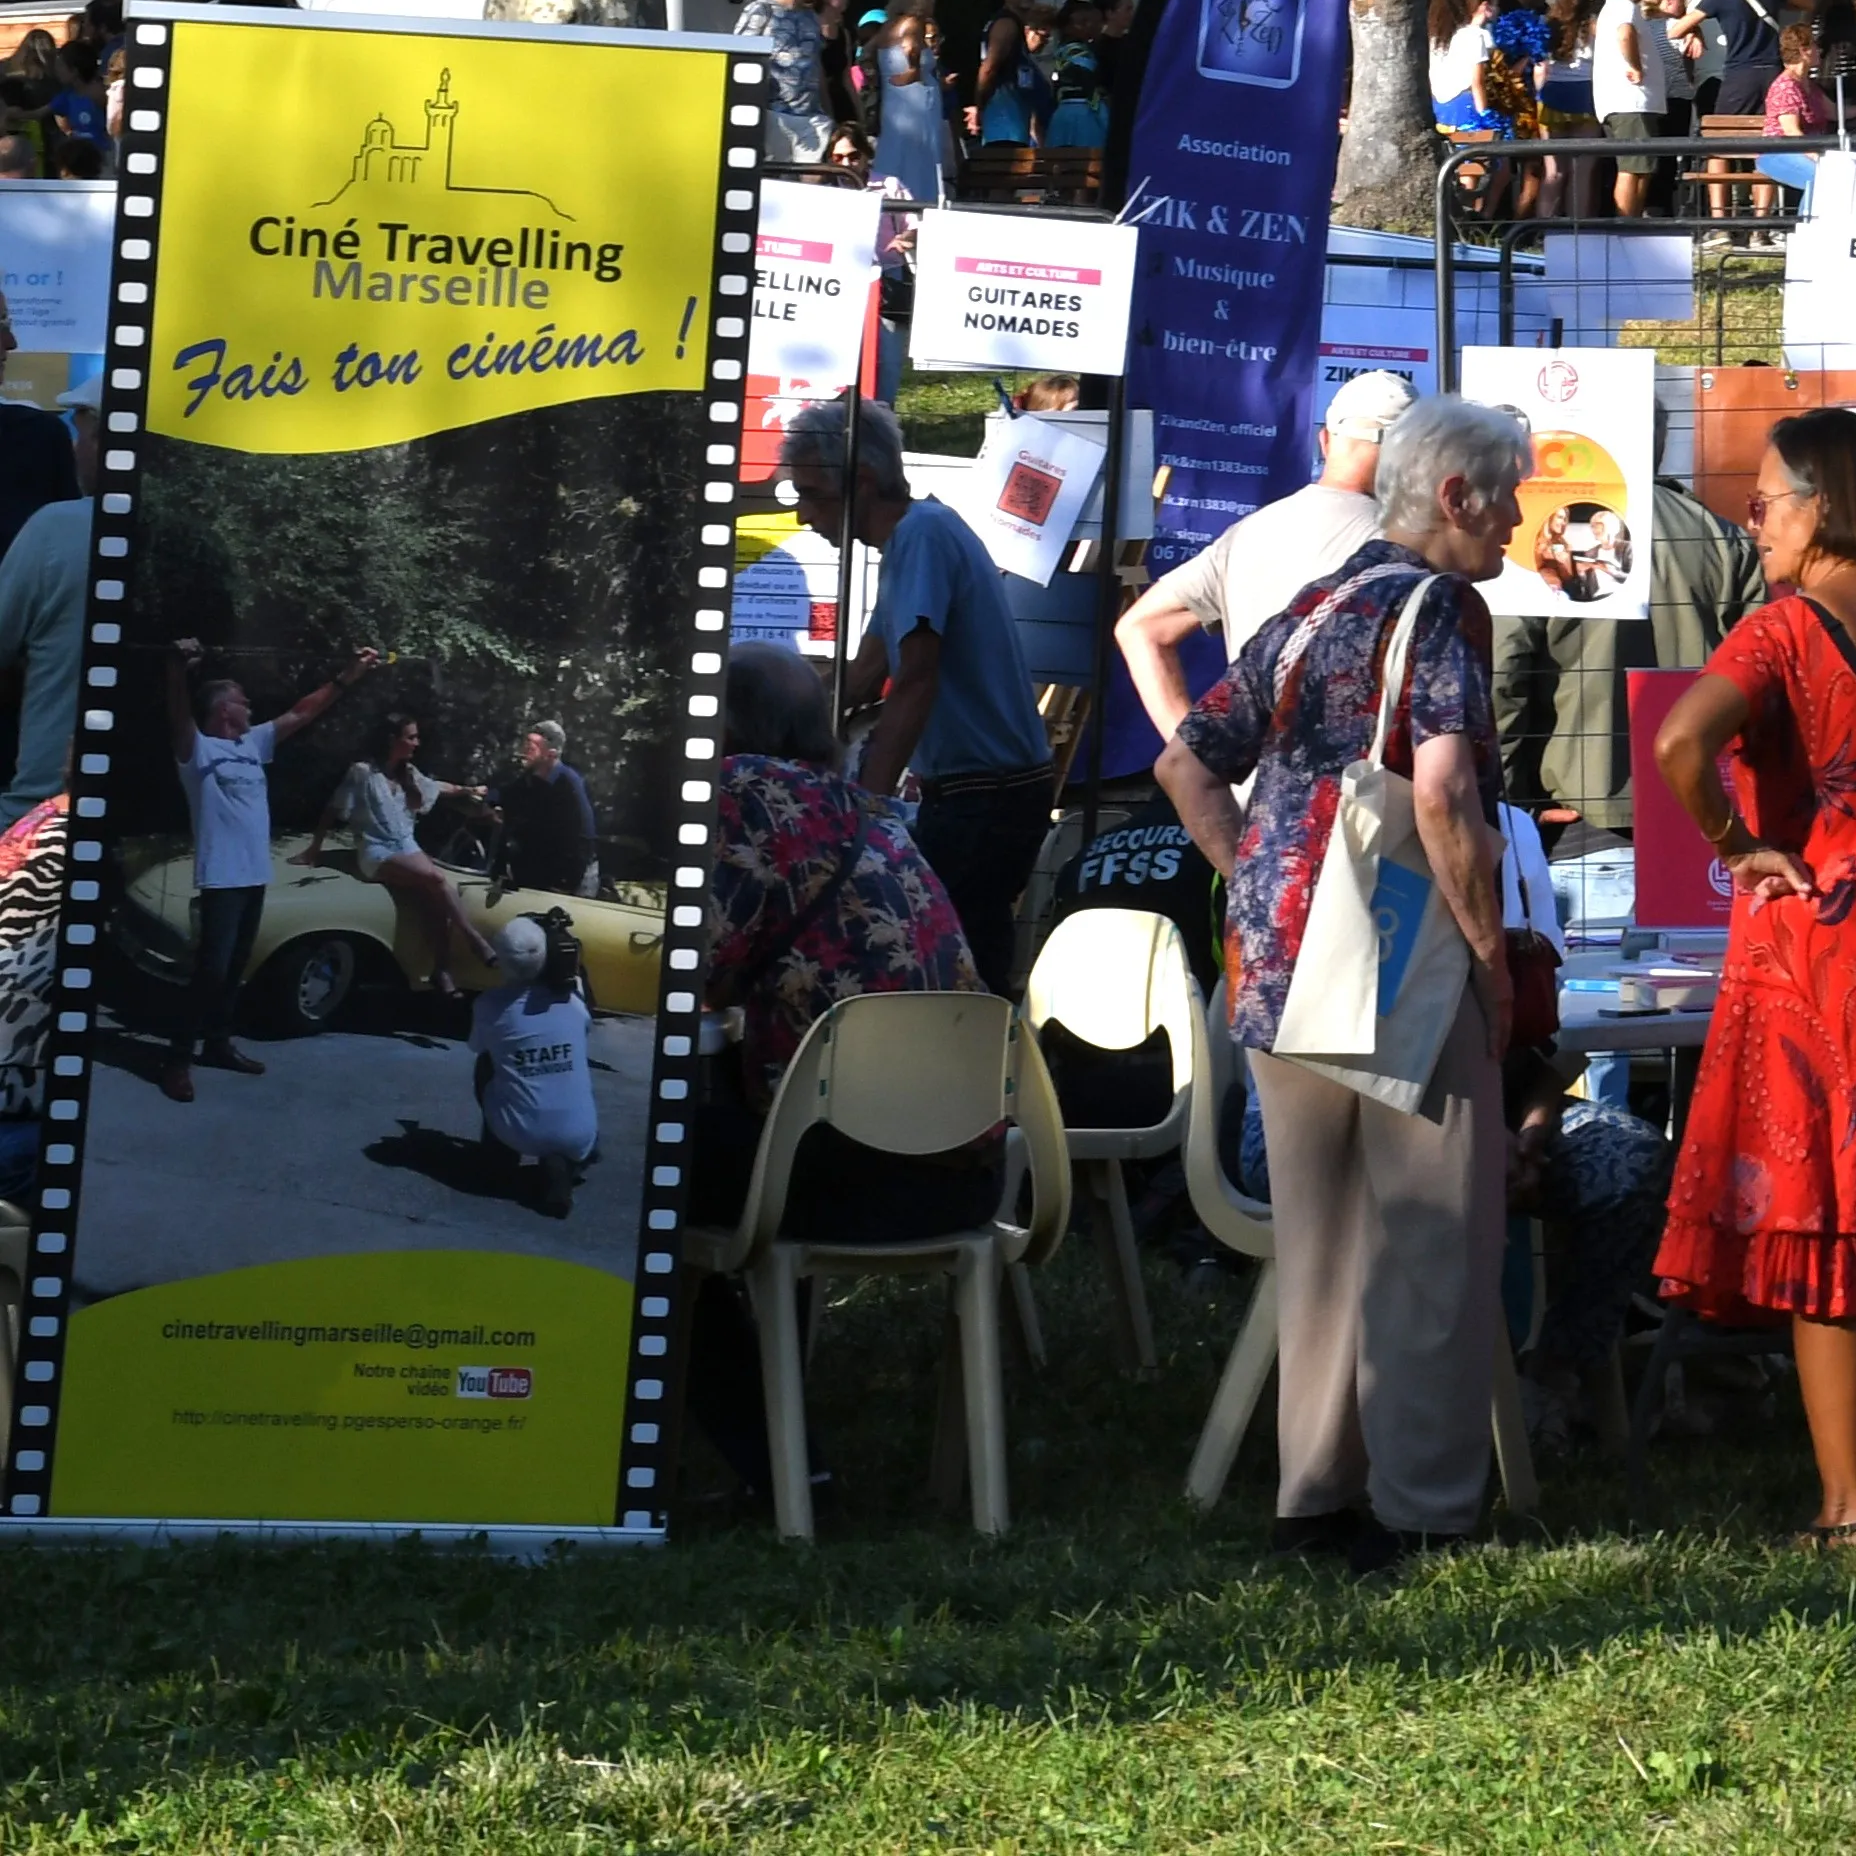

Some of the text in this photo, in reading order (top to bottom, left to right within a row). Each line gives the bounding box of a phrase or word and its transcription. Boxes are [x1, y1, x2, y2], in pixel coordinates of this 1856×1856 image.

[1177, 134, 1292, 166] Association
[1140, 195, 1311, 244] ZIK & ZEN
[248, 215, 626, 283] Ciné Travelling
[26, 272, 50, 287] or
[312, 260, 551, 311] Marseille
[754, 269, 842, 297] ELLING
[975, 262, 1079, 281] ARTS ET CULTURE
[1172, 256, 1276, 290] Musique
[967, 286, 1083, 312] GUITARES
[1213, 299, 1230, 321] &
[963, 312, 1080, 339] NOMADES
[172, 295, 700, 420] Fais ton cinéma !
[1163, 330, 1278, 362] bien-être
[1018, 450, 1067, 476] Guitares
[1153, 545, 1174, 560] 06
[1086, 825, 1193, 857] SECOURS
[1078, 848, 1183, 893] FFSS
[514, 1043, 572, 1068] STAFF
[161, 1319, 536, 1351] cinetravellingmarseille@gmail.com
[353, 1363, 397, 1380] Notre
[457, 1369, 531, 1397] YouTube
[406, 1381, 450, 1397] vidéo
